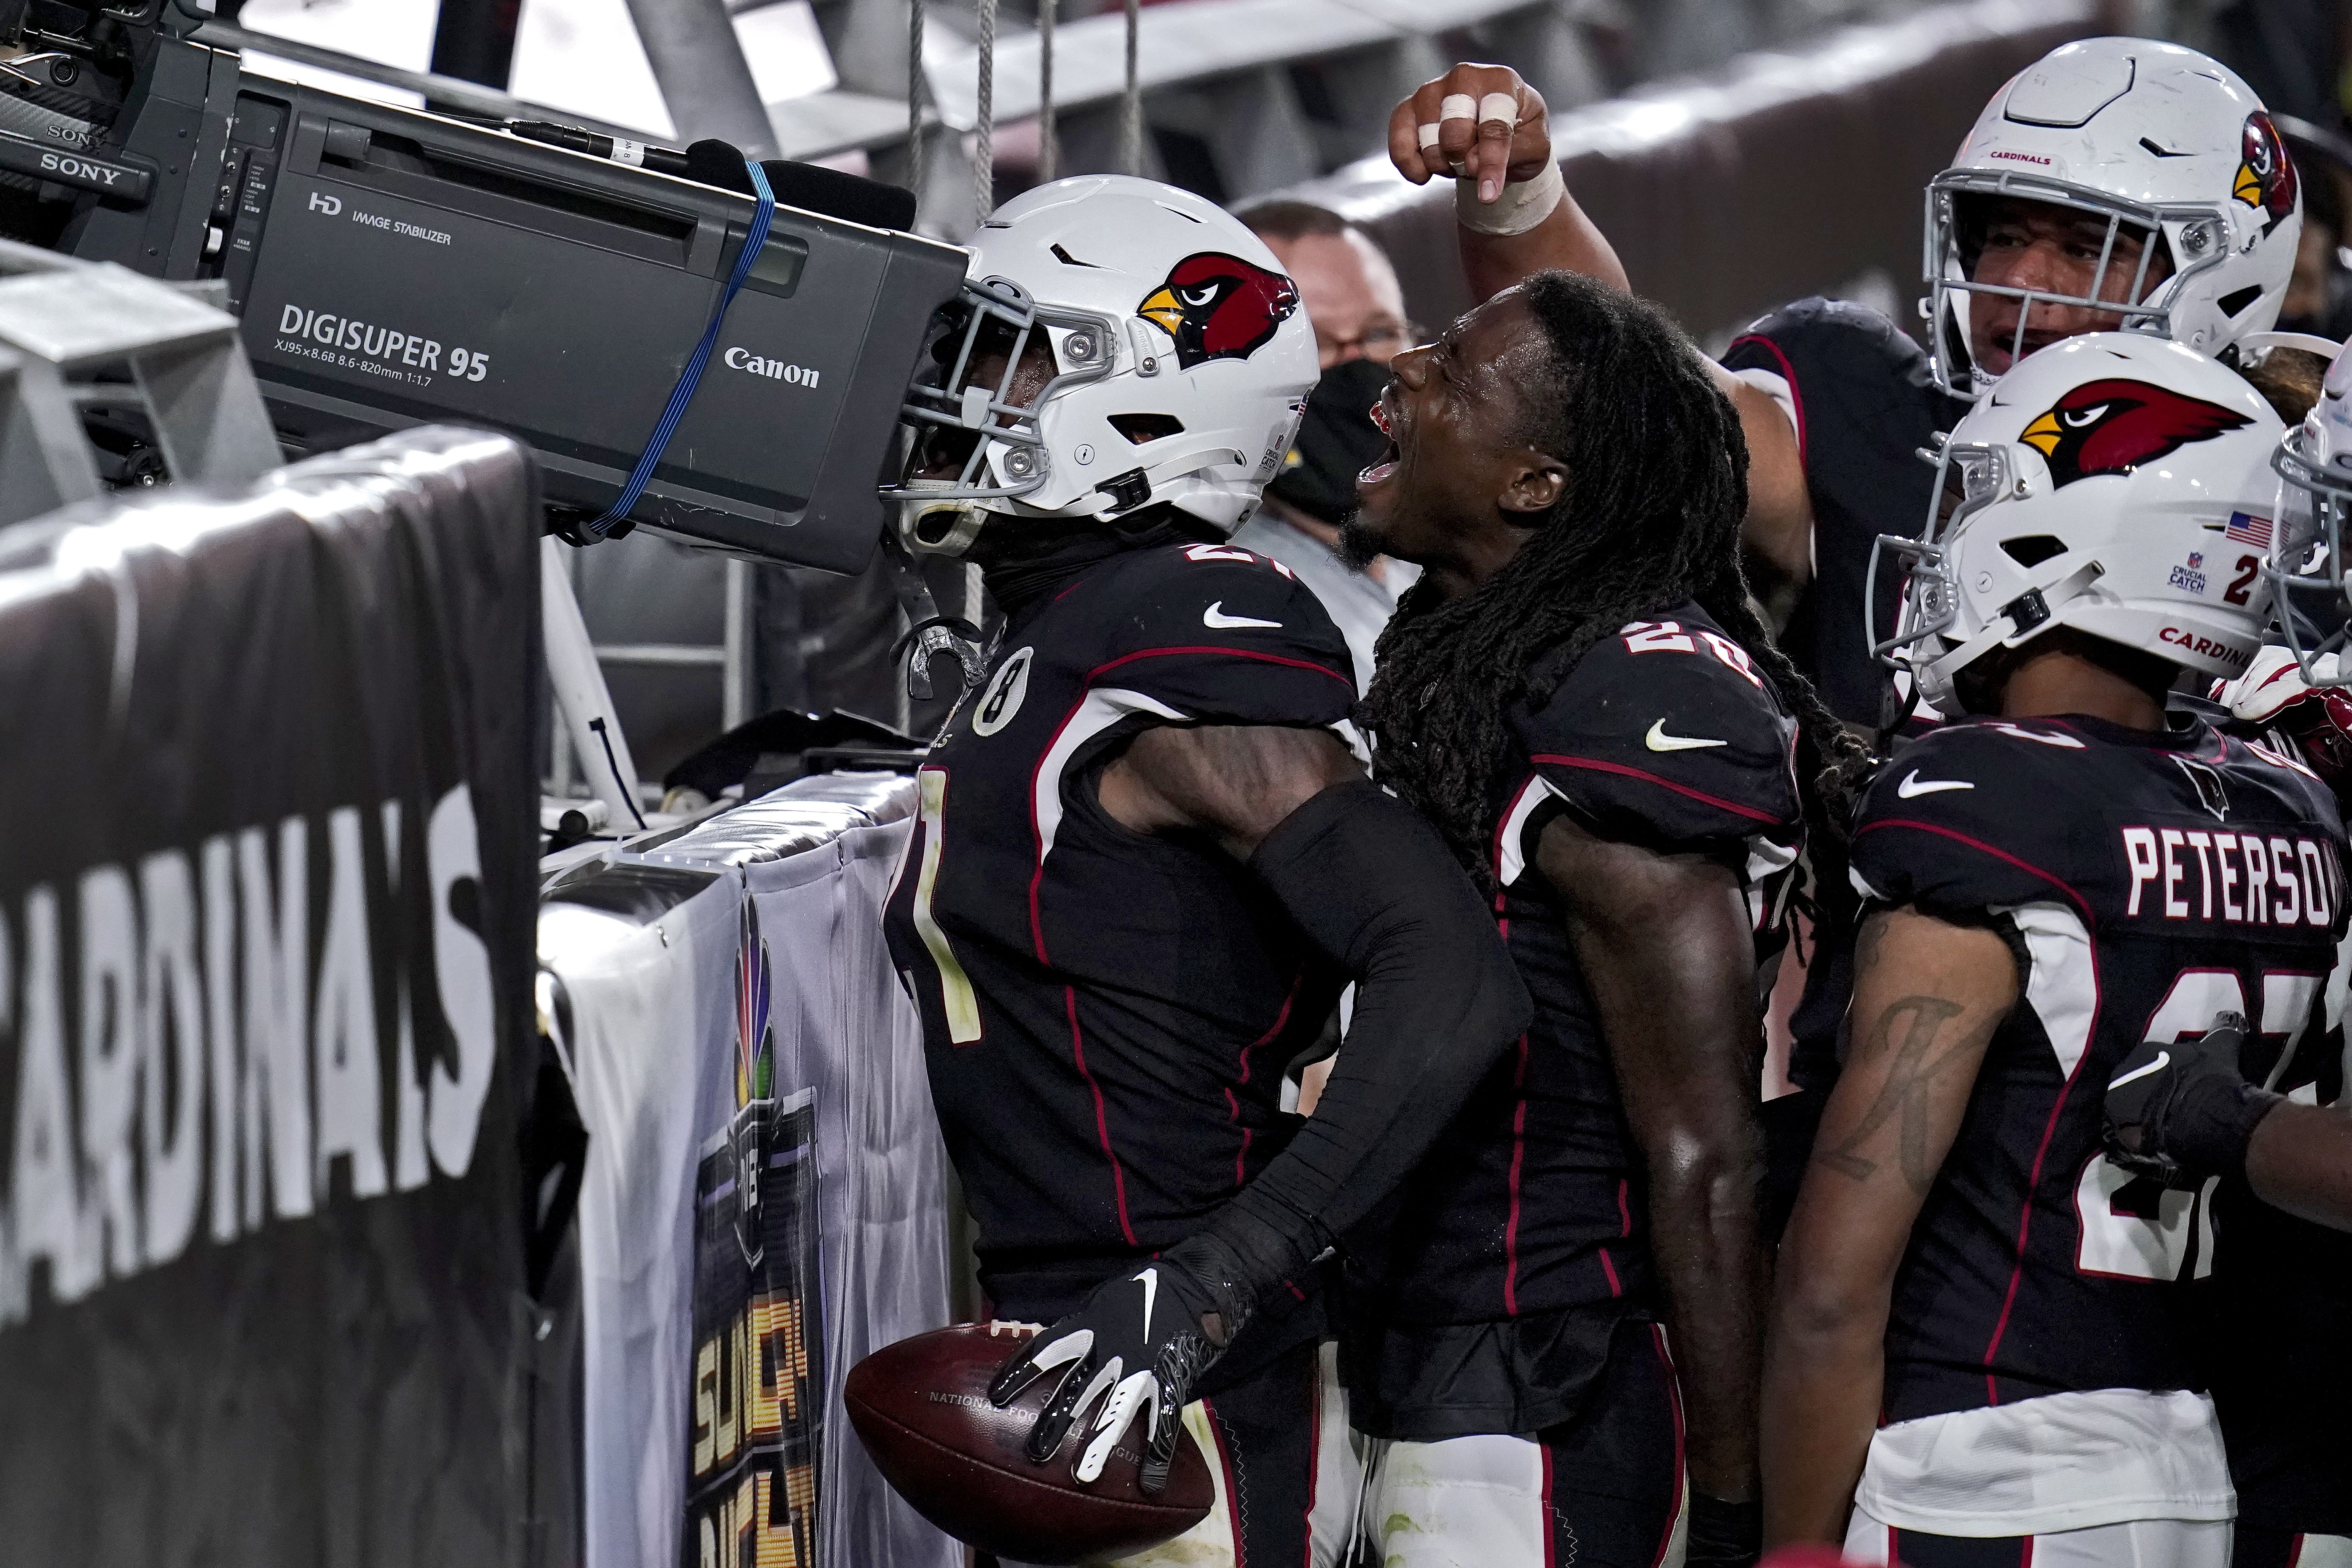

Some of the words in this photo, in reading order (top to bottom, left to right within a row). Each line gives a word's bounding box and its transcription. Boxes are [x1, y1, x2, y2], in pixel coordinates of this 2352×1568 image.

[47, 126, 93, 145] SON
[40, 153, 121, 185] SONY
[1990, 151, 2051, 165] CARDINALS
[308, 192, 342, 216] HD
[353, 211, 391, 230] IMAGE
[393, 221, 451, 245] STABILIZER
[279, 304, 441, 371] DIGISUPER
[448, 347, 489, 383] 95
[338, 355, 402, 381] 8.6-820mm
[407, 372, 432, 387] 1:1.7
[724, 347, 820, 389] Canon
[1261, 456, 1277, 470] CATCH
[2170, 574, 2205, 591] CATCH
[2173, 565, 2206, 582] CRUCIAL
[0, 782, 497, 1327] ARDINALS
